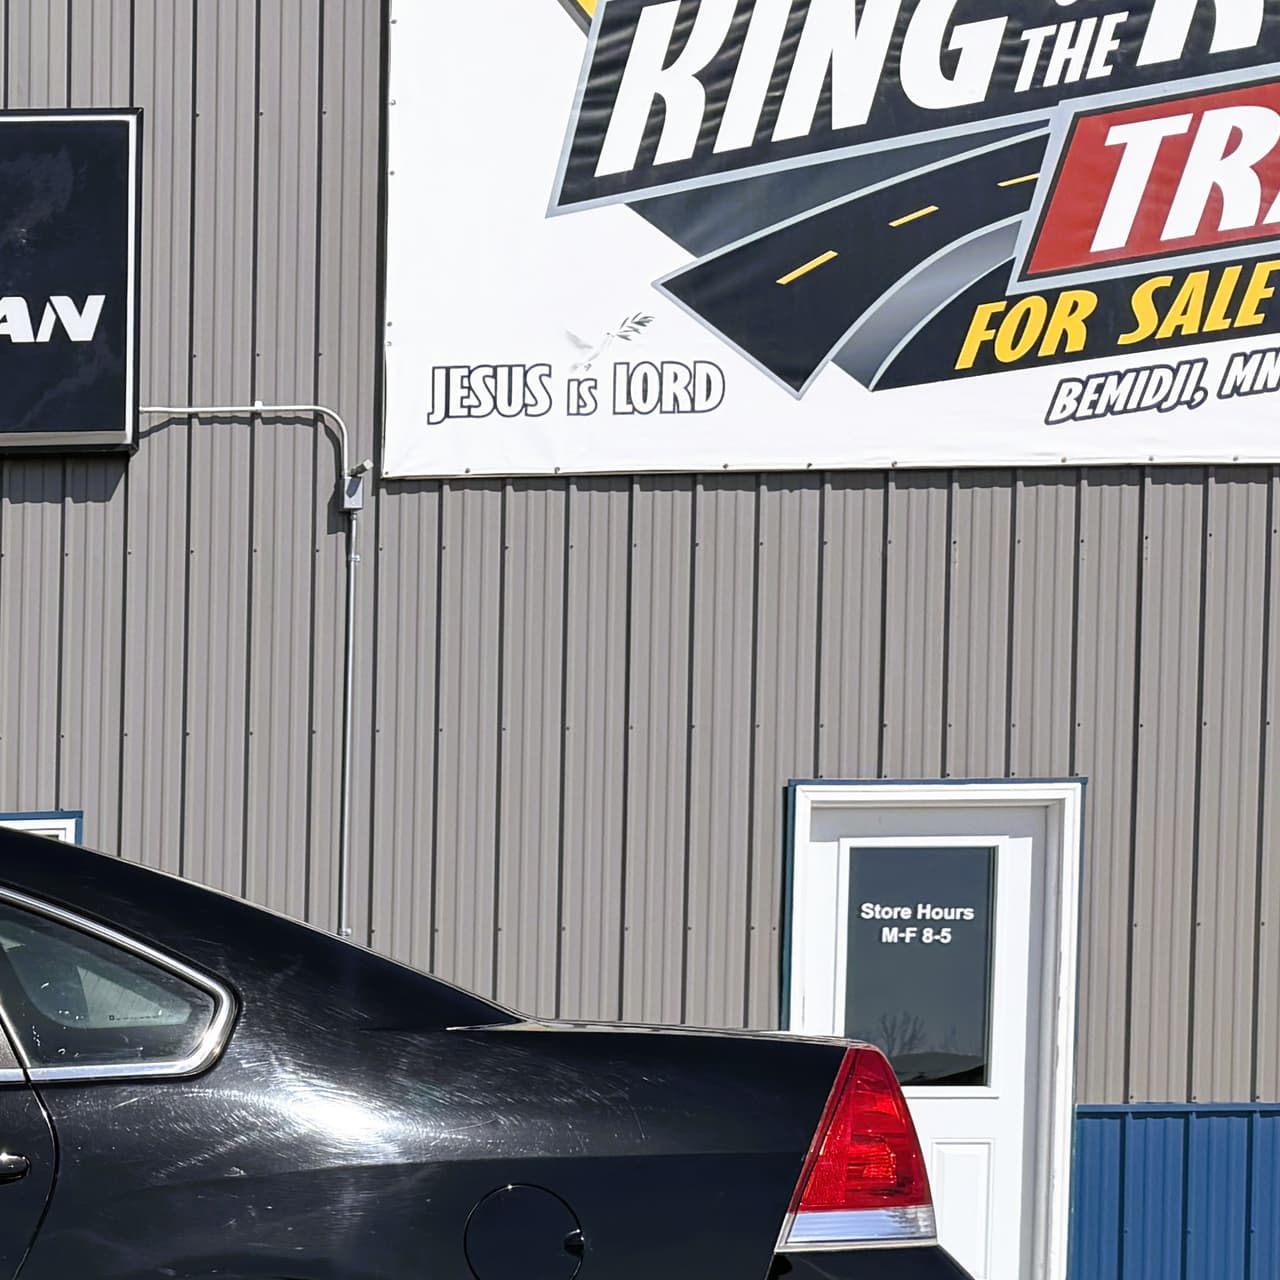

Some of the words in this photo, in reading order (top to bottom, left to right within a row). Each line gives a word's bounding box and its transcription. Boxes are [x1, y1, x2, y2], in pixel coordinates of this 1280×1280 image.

[594, 0, 1008, 178] KING
[1014, 11, 1130, 93] THE
[1089, 105, 1280, 252] TR
[953, 289, 1098, 371] FOR
[1116, 259, 1280, 346] SALE
[427, 364, 552, 425] JESUS
[613, 360, 726, 416] LORD
[1044, 356, 1209, 426] BEMIDJI,
[860, 902, 912, 919] Store
[917, 903, 975, 920] Hours
[882, 927, 918, 943] M-F
[922, 927, 952, 944] 8-5
